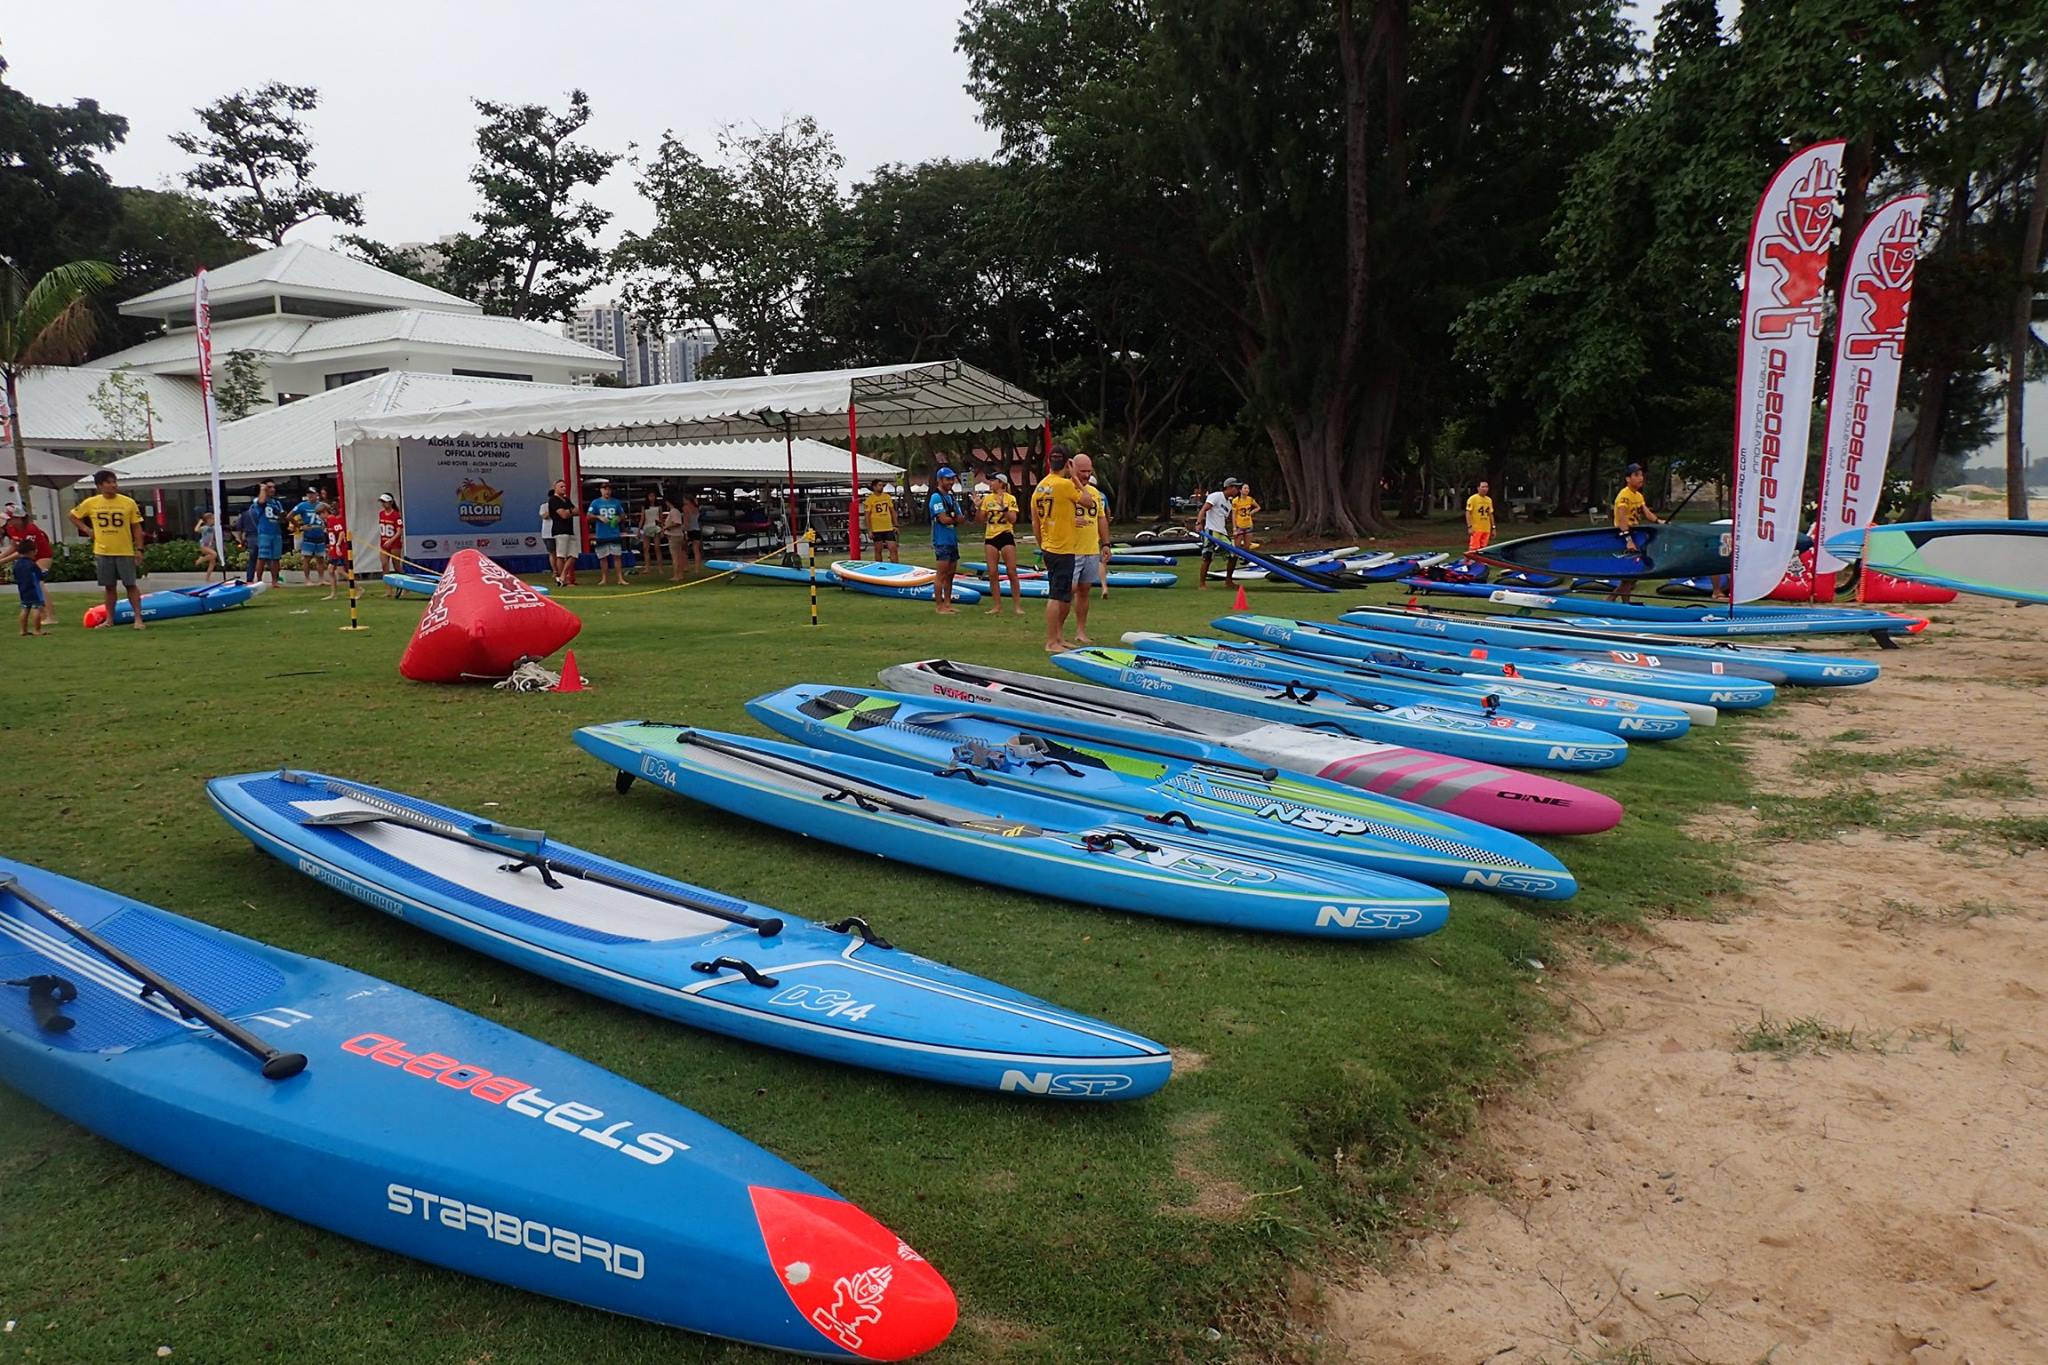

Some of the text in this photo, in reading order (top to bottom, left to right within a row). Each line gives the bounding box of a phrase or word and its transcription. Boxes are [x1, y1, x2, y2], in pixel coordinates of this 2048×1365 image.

[428, 439, 524, 449] ALOHA SEA SPORTS CENTRE
[444, 449, 510, 459] OFFICIAL OPENING
[1758, 348, 1787, 542] STARBOARD
[1841, 367, 1872, 526] STARBOARD
[459, 505, 501, 515] ALOHA
[1036, 497, 1053, 518] 57
[96, 512, 124, 528] 56
[1709, 690, 1762, 703] NSP
[1618, 717, 1680, 733] NSP
[1547, 745, 1616, 763] NSP
[1255, 803, 1368, 837] NSP
[1461, 869, 1557, 893] NSP
[1315, 905, 1423, 930] NSP
[768, 984, 877, 1022] DC14
[1000, 1069, 1134, 1097] NSP
[340, 1032, 692, 1165] STARBOARD
[387, 1183, 645, 1280] STARBOARD
